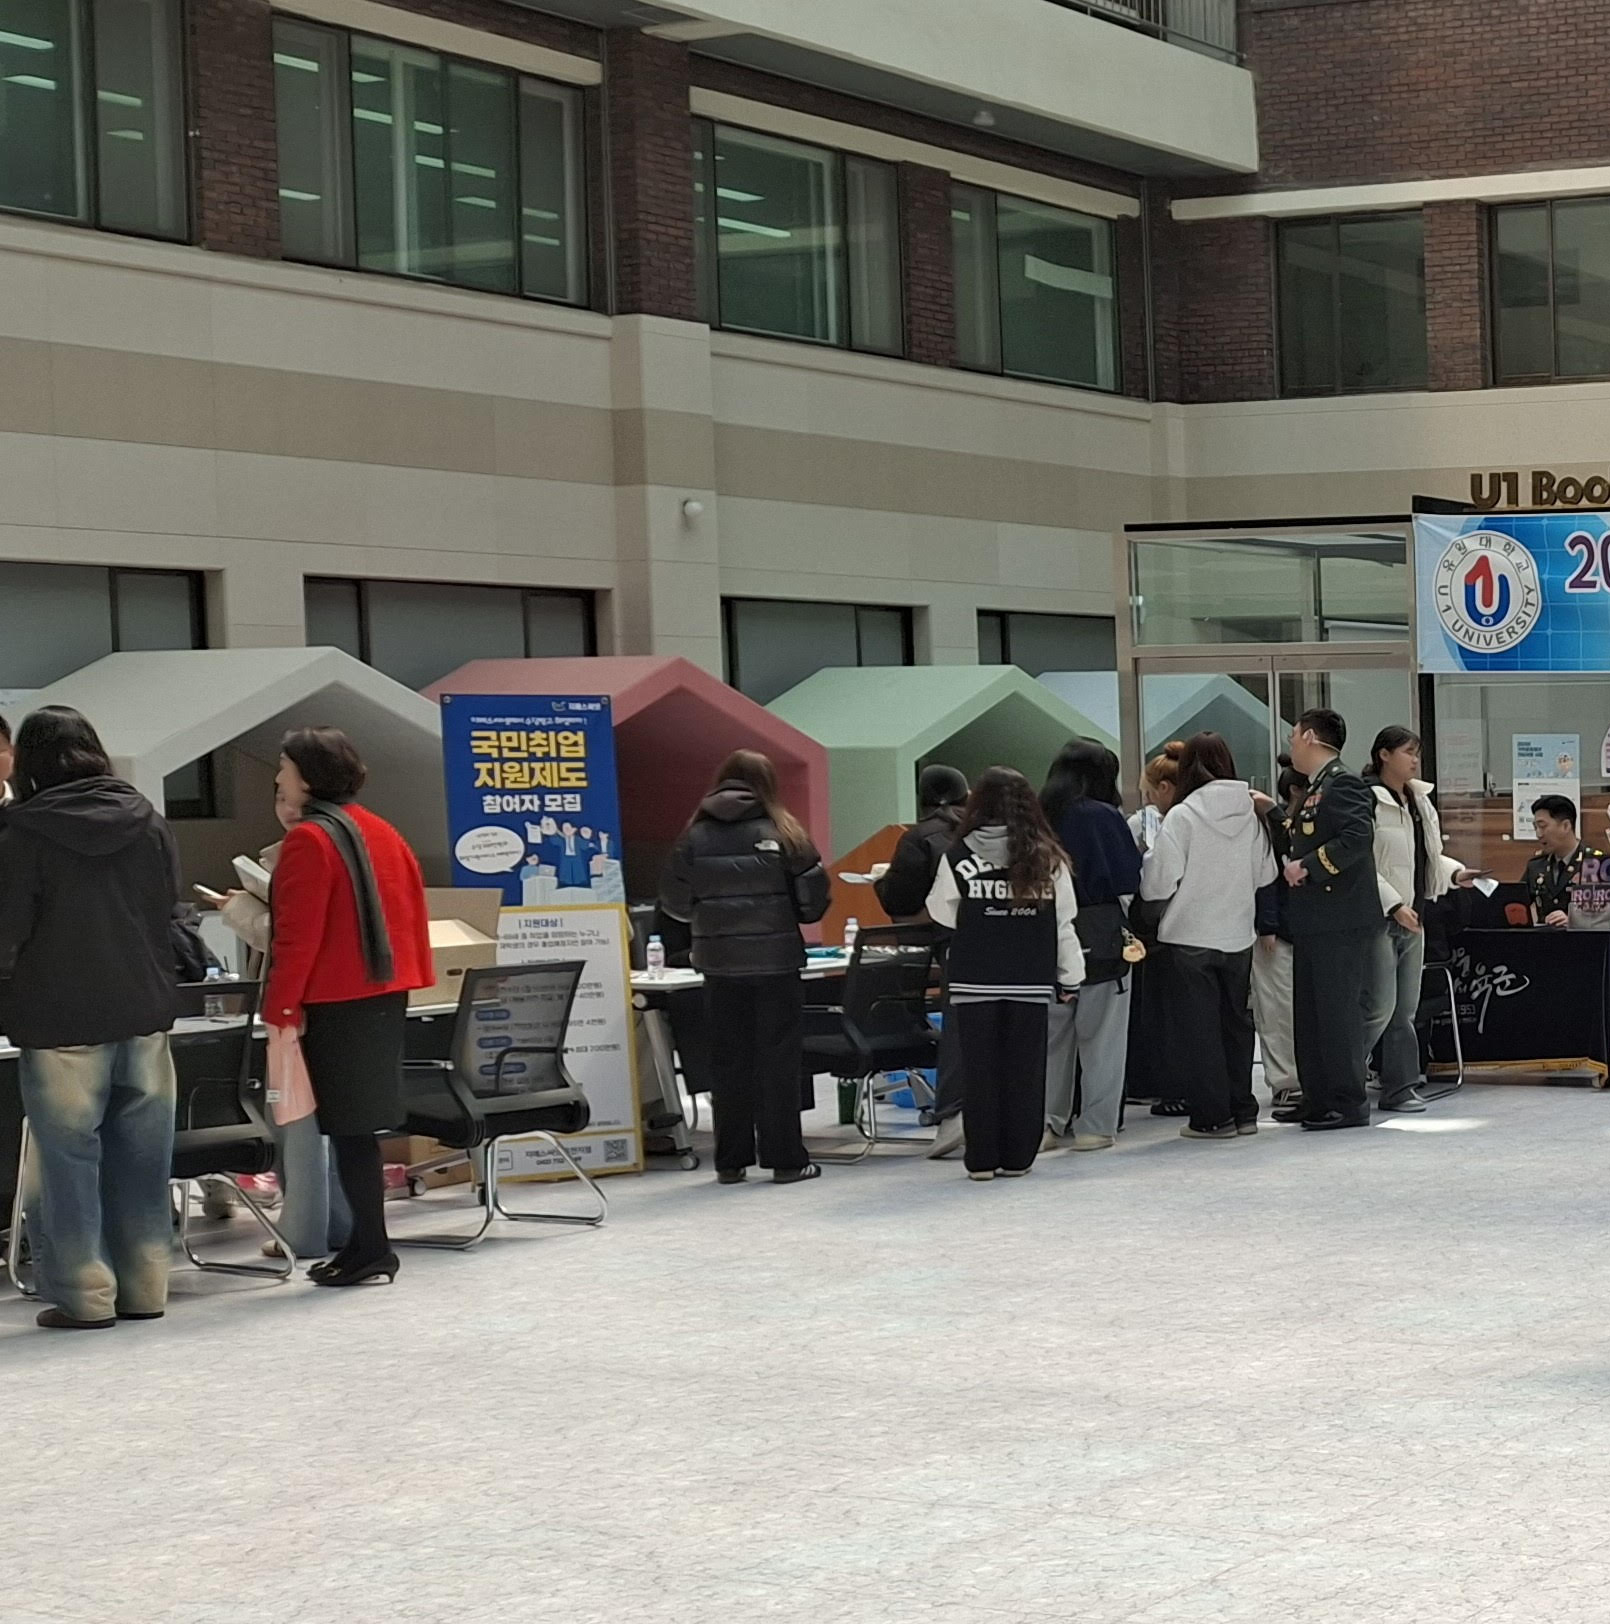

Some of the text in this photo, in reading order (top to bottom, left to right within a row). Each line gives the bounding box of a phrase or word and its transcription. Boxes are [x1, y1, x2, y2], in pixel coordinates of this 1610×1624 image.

[1471, 471, 1518, 508] U1
[1450, 583, 1537, 647] UNIVERSITY
[470, 729, 588, 759] 국민취업
[473, 761, 589, 790] 지원제도
[481, 793, 583, 814] 참여자 모집
